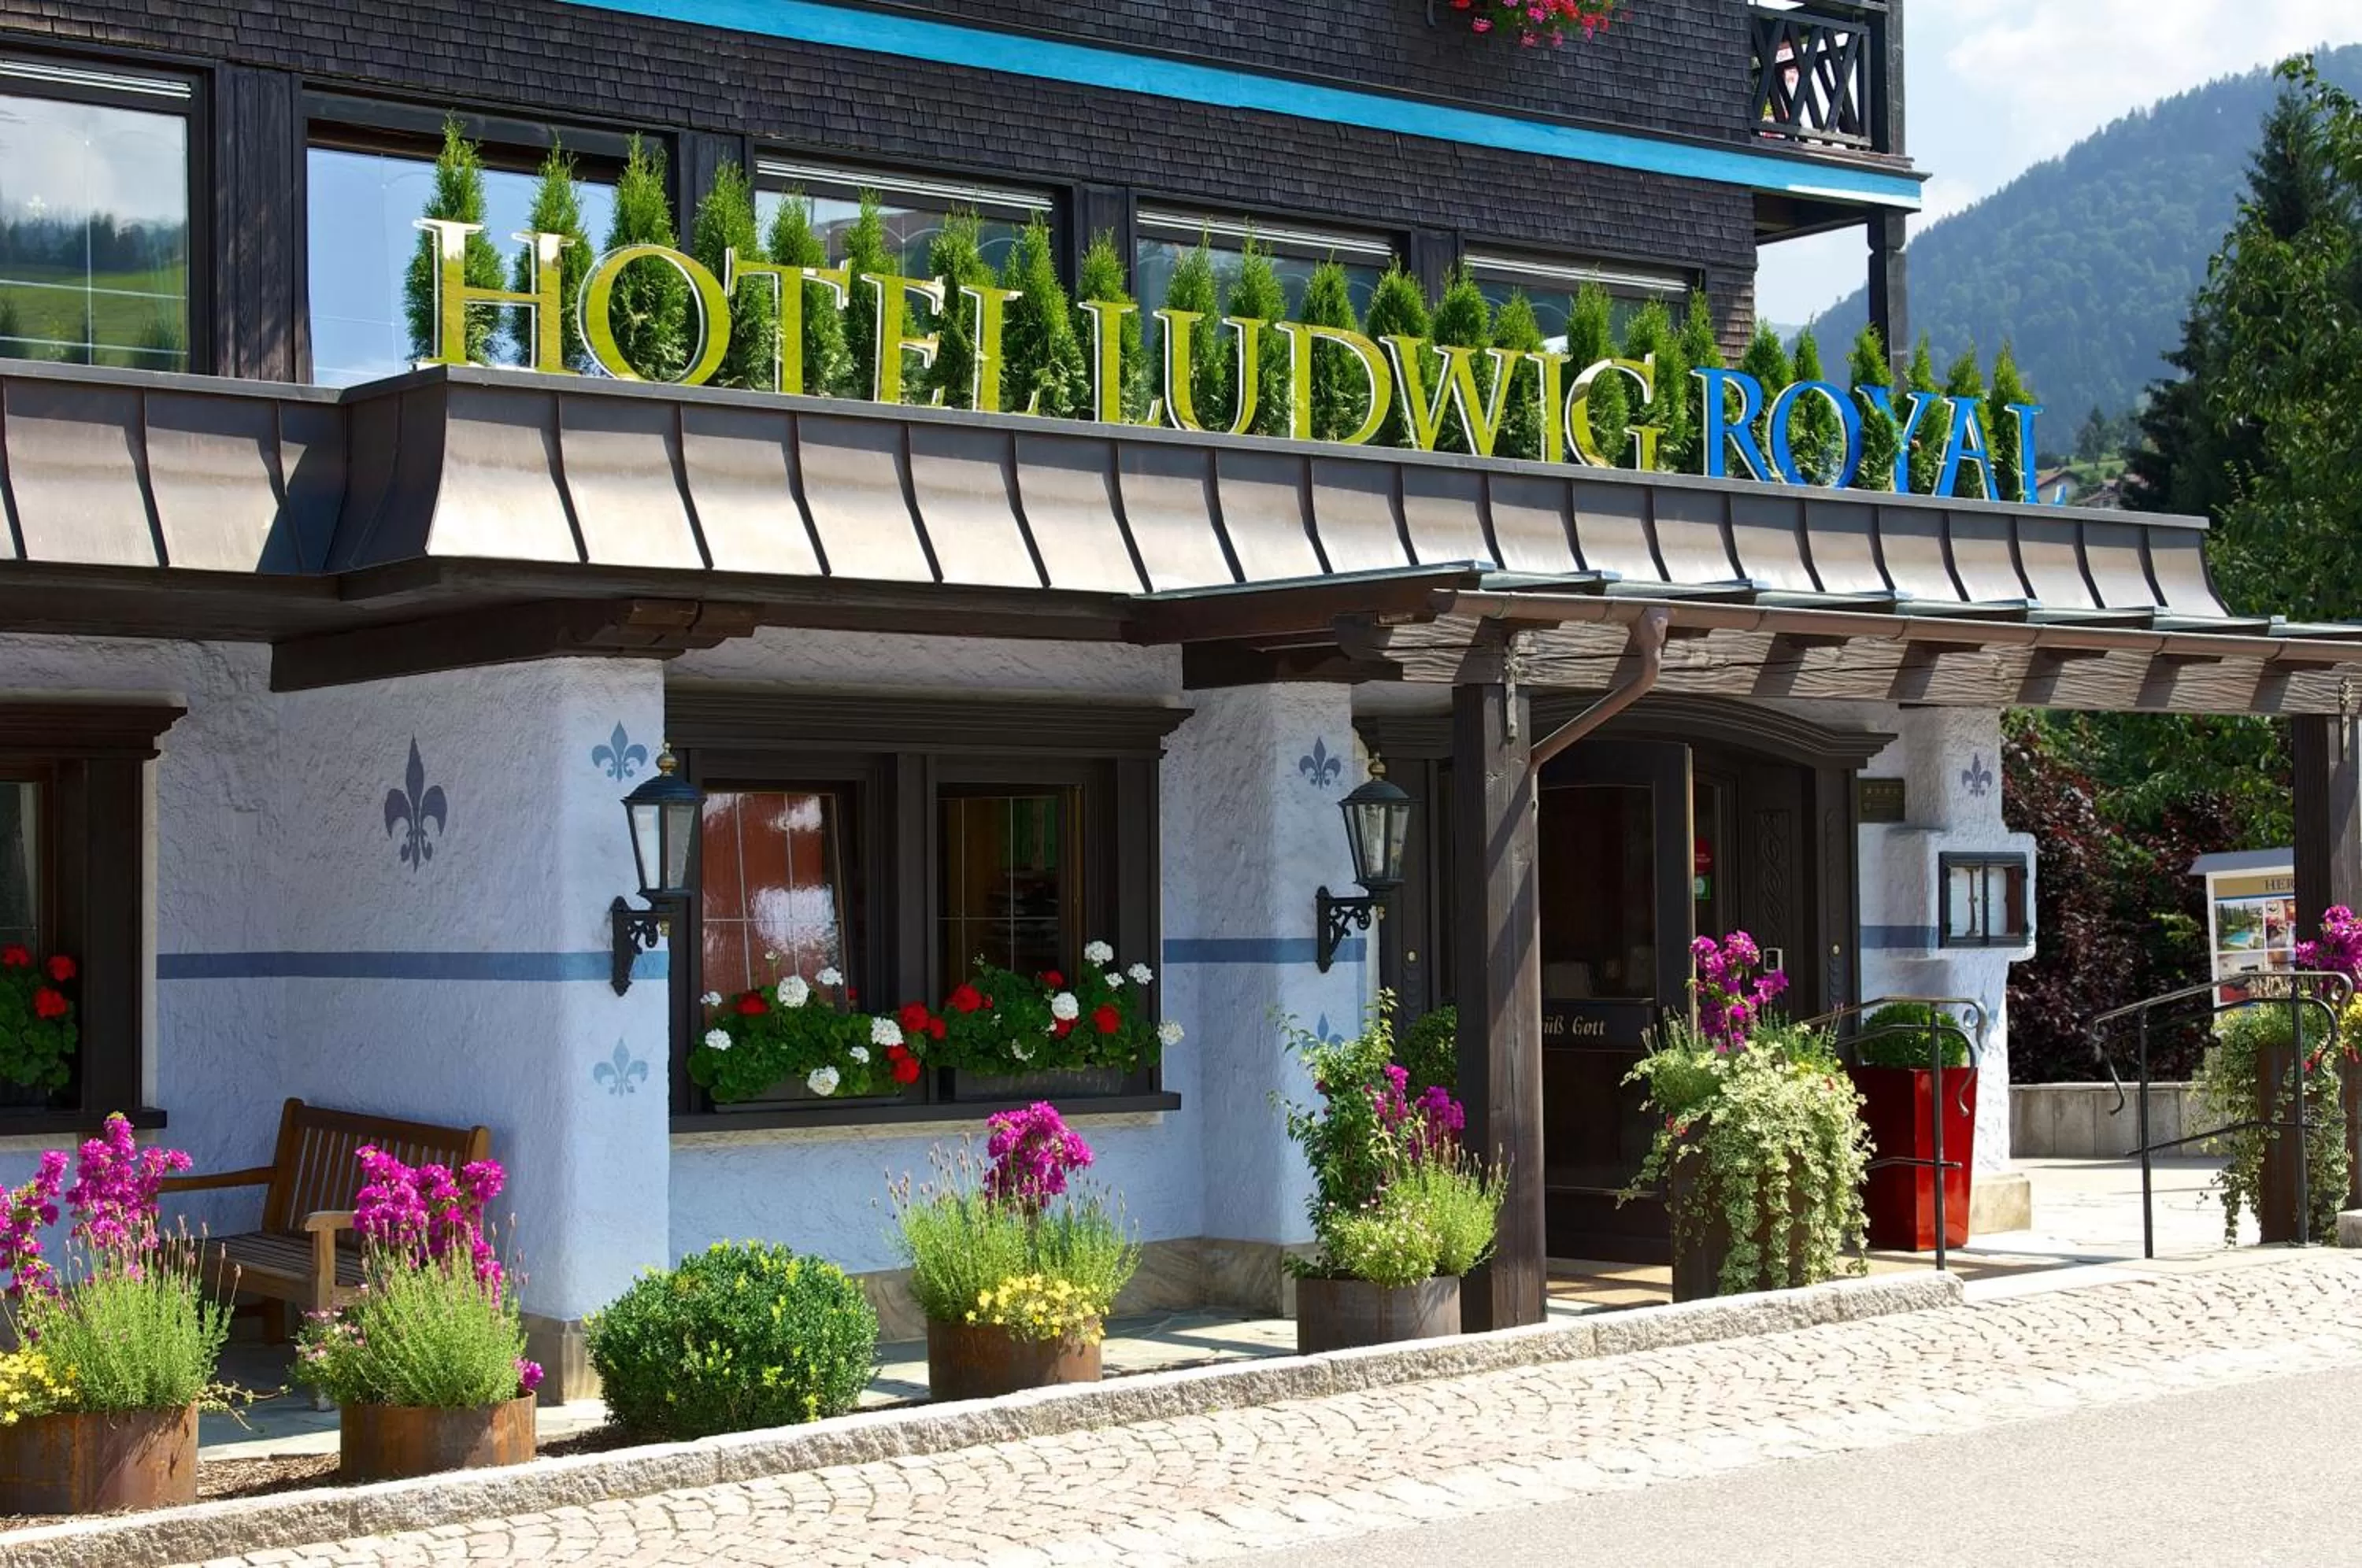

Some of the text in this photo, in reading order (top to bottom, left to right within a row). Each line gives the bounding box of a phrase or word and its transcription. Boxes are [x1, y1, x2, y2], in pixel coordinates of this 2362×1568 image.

[413, 217, 2067, 506] HOTEL LUDWIG ROYAL
[1543, 1015, 1605, 1037] üß Gott
